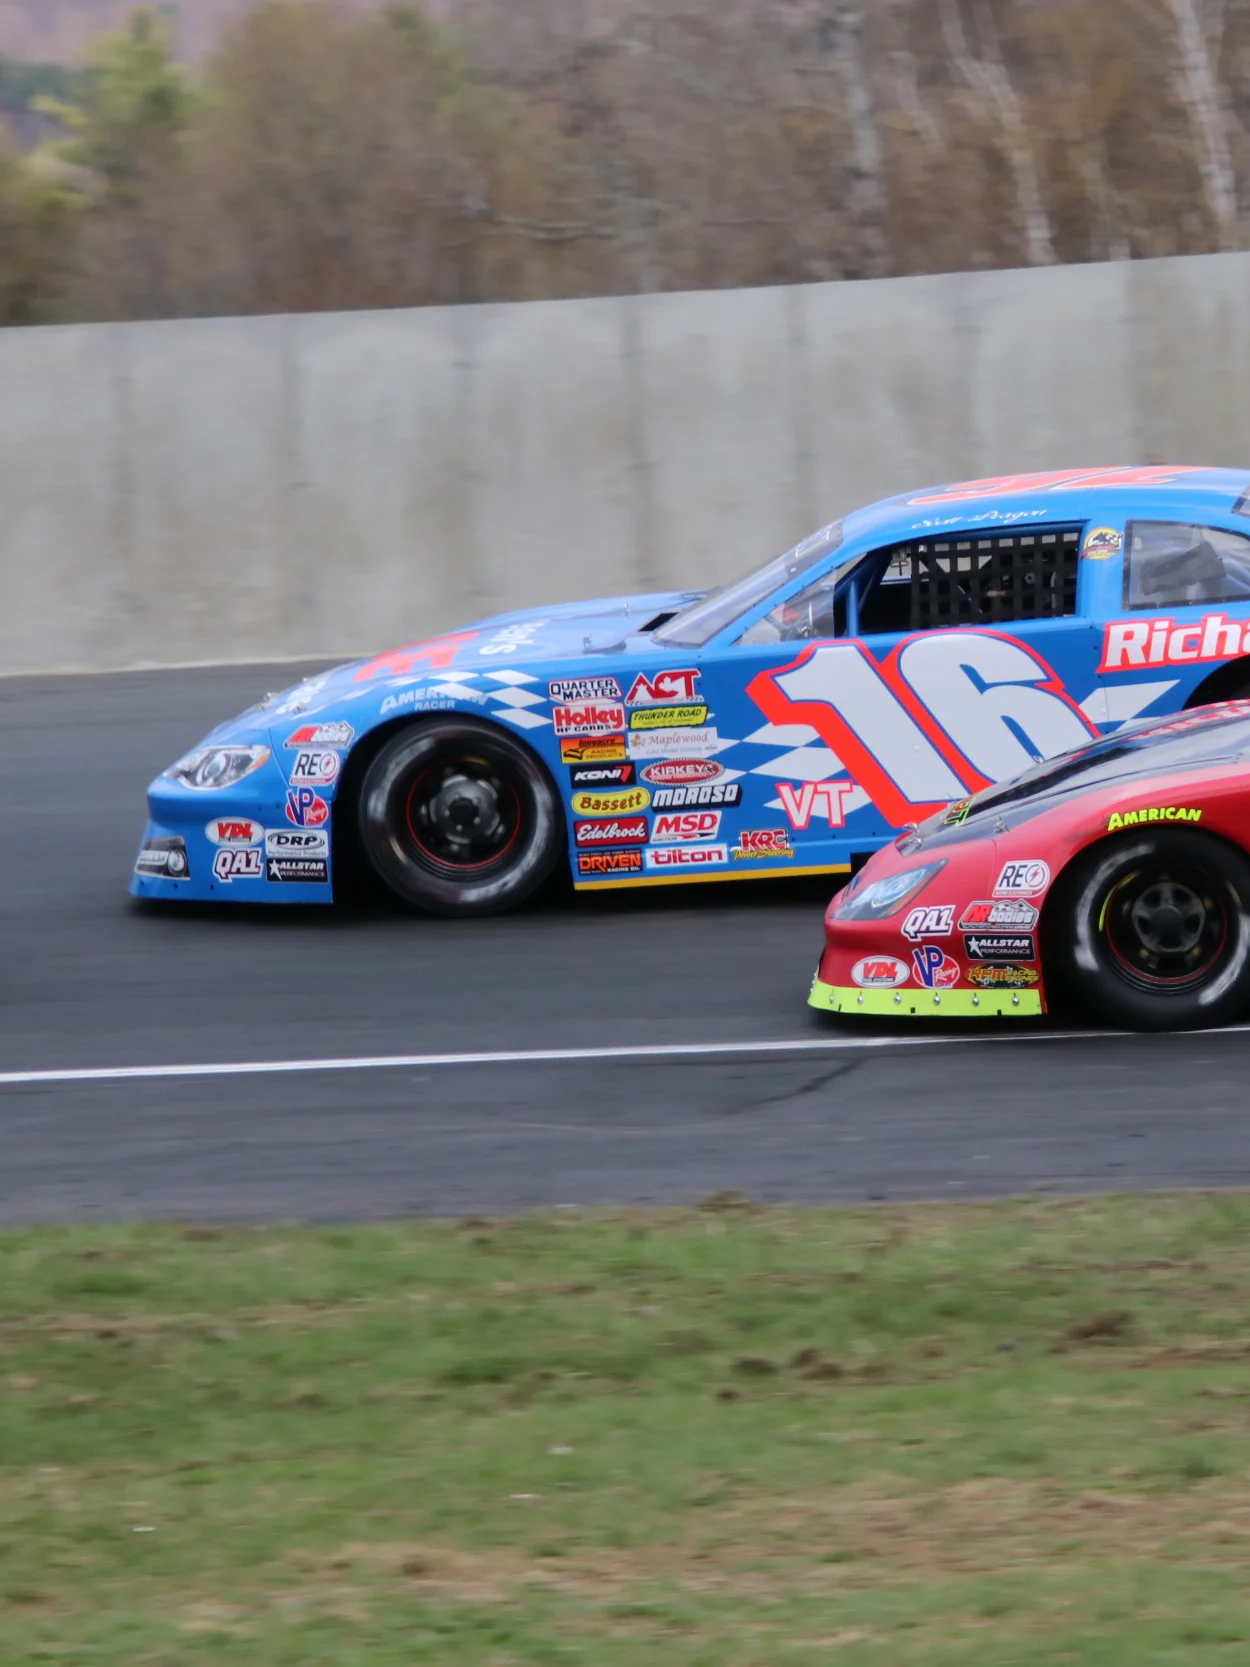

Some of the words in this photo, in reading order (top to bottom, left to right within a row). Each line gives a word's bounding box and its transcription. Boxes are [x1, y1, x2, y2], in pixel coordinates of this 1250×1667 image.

[550, 679, 614, 695] QUARTER
[627, 670, 701, 701] ACT
[563, 688, 618, 701] MASTER
[414, 700, 456, 711] RACER
[555, 705, 623, 729] Holley
[633, 710, 675, 721] THUNDER
[677, 708, 702, 717] ROAD
[574, 724, 612, 732] CARBS
[755, 630, 1098, 818] 16
[648, 731, 710, 747] Maplewood
[574, 769, 622, 781] KONI
[650, 764, 706, 776] KIRKEY
[580, 792, 642, 811] Bassett
[652, 784, 739, 808] MOROSO
[776, 780, 854, 829] VT
[286, 787, 314, 826] VP
[655, 813, 718, 834] MSD
[1107, 807, 1203, 832] AMERICAN
[217, 821, 253, 838] VDL
[577, 820, 646, 841] Edelbrock
[276, 835, 319, 846] DRP
[740, 829, 787, 851] KRC
[578, 853, 642, 872] DRIVEN
[653, 848, 723, 864] tilton
[215, 850, 260, 880] QA1
[278, 861, 325, 870] ALLSTAR
[280, 870, 326, 878] PERFORMANCE
[903, 907, 952, 939] QA1
[978, 938, 1031, 947] ALLSTAR
[863, 961, 898, 978] VDL
[912, 945, 945, 987] VP
[967, 968, 1006, 981] RPM
